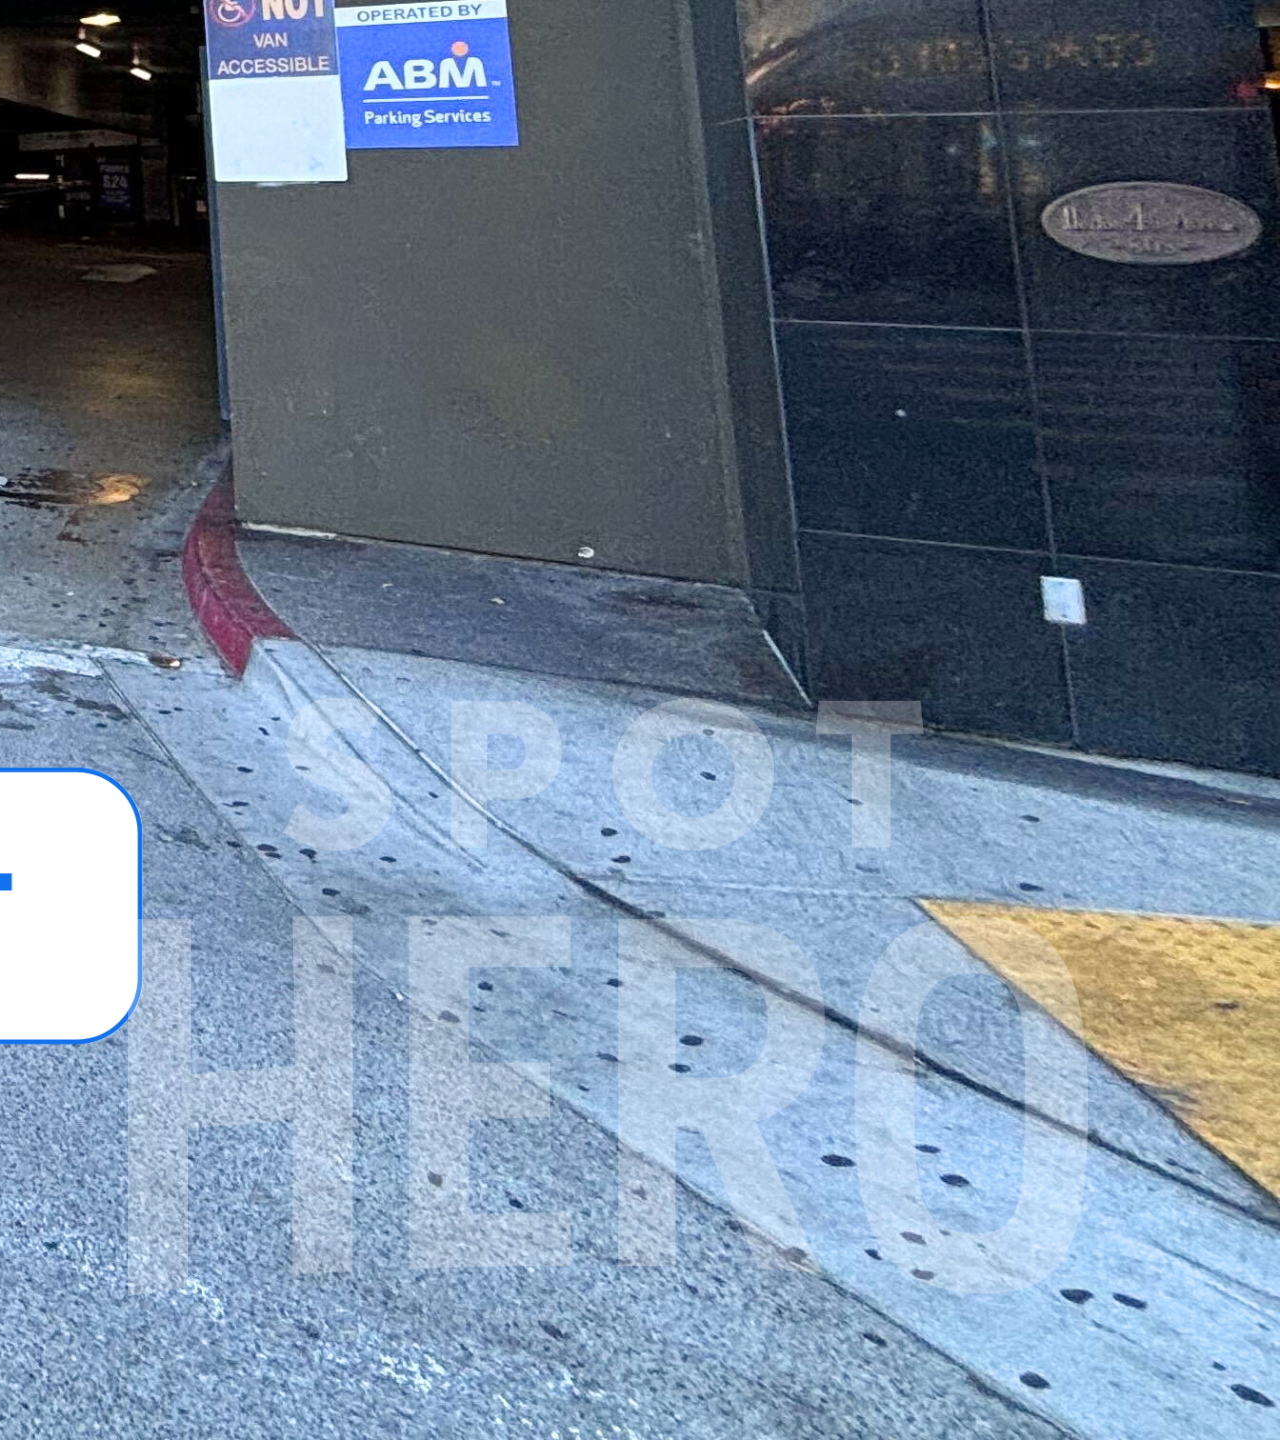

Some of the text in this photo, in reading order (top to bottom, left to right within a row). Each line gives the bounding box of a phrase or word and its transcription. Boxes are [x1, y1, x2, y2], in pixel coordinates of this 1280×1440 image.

[356, 3, 482, 23] OPERATED BY
[253, 33, 289, 48] VAN
[217, 56, 331, 76] ACCESSIBLE
[362, 56, 488, 92] ABM
[364, 109, 491, 128] Parking Services
